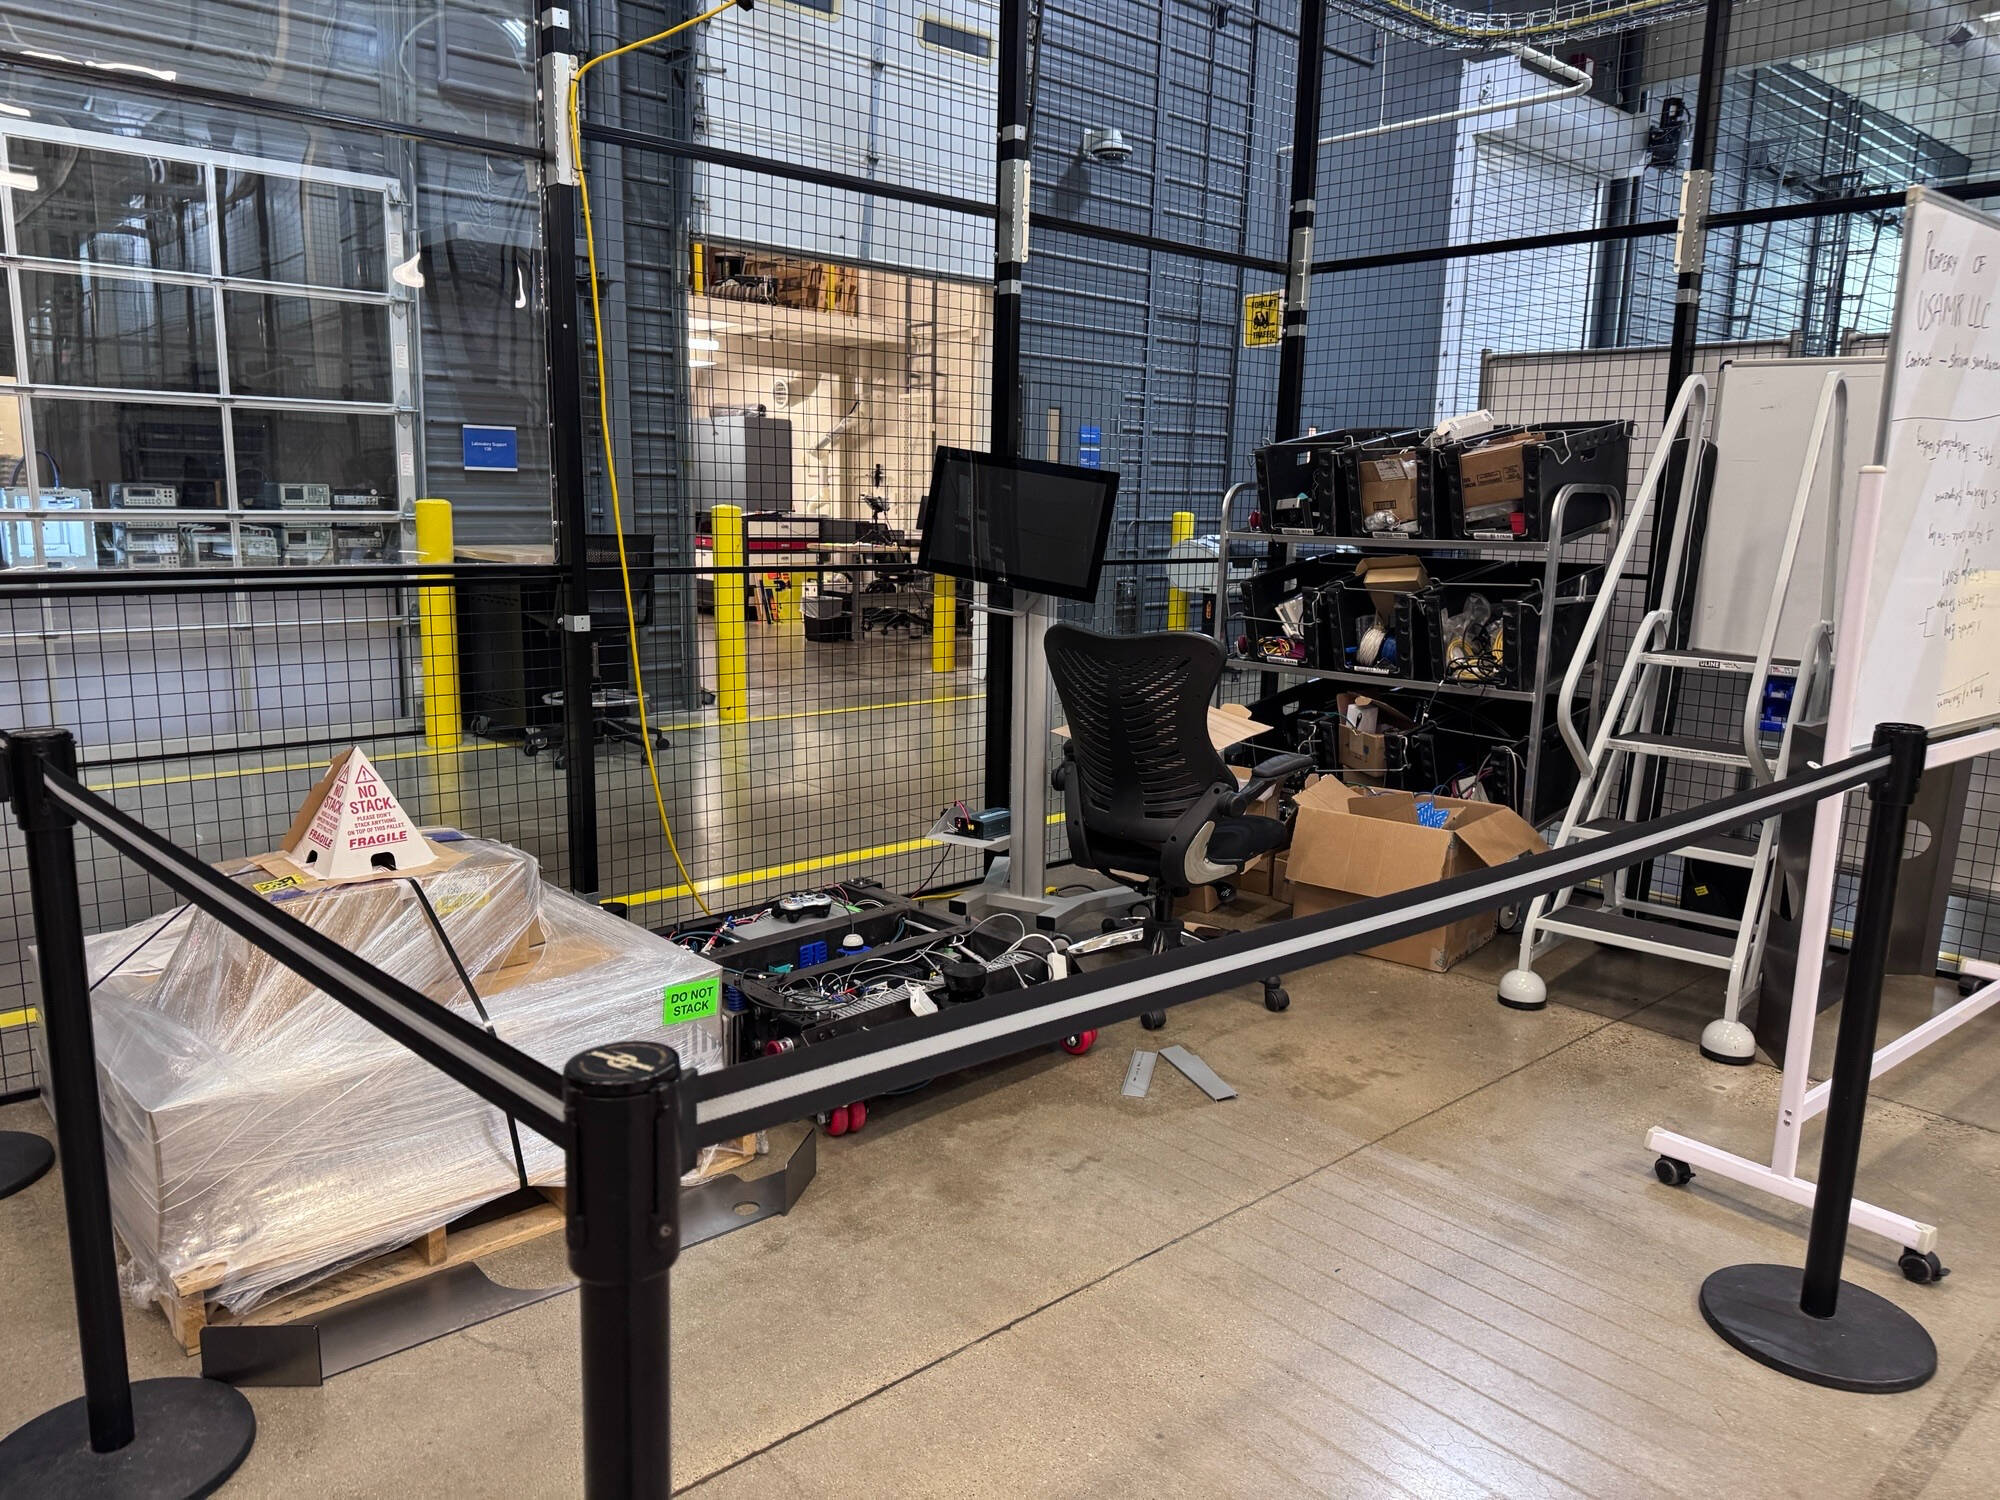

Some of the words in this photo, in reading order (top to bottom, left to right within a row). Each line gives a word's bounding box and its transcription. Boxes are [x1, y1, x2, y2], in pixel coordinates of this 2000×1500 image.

[1972, 254, 1988, 274] OF
[1252, 299, 1277, 308] FORKLIFT
[1967, 294, 1992, 329] LLC
[1253, 330, 1276, 339] TRAFFIC
[333, 784, 344, 798] NO
[357, 784, 378, 799] NO
[349, 797, 396, 815] STACK.
[354, 821, 370, 829] STACK
[371, 817, 396, 825] ANYTHING
[357, 814, 375, 822] PLEASE
[309, 828, 333, 848] FRAGILE
[349, 831, 407, 848] FRAGILE
[671, 991, 688, 1004] DO
[690, 986, 714, 1000] NOT
[673, 1000, 709, 1017] STACK
